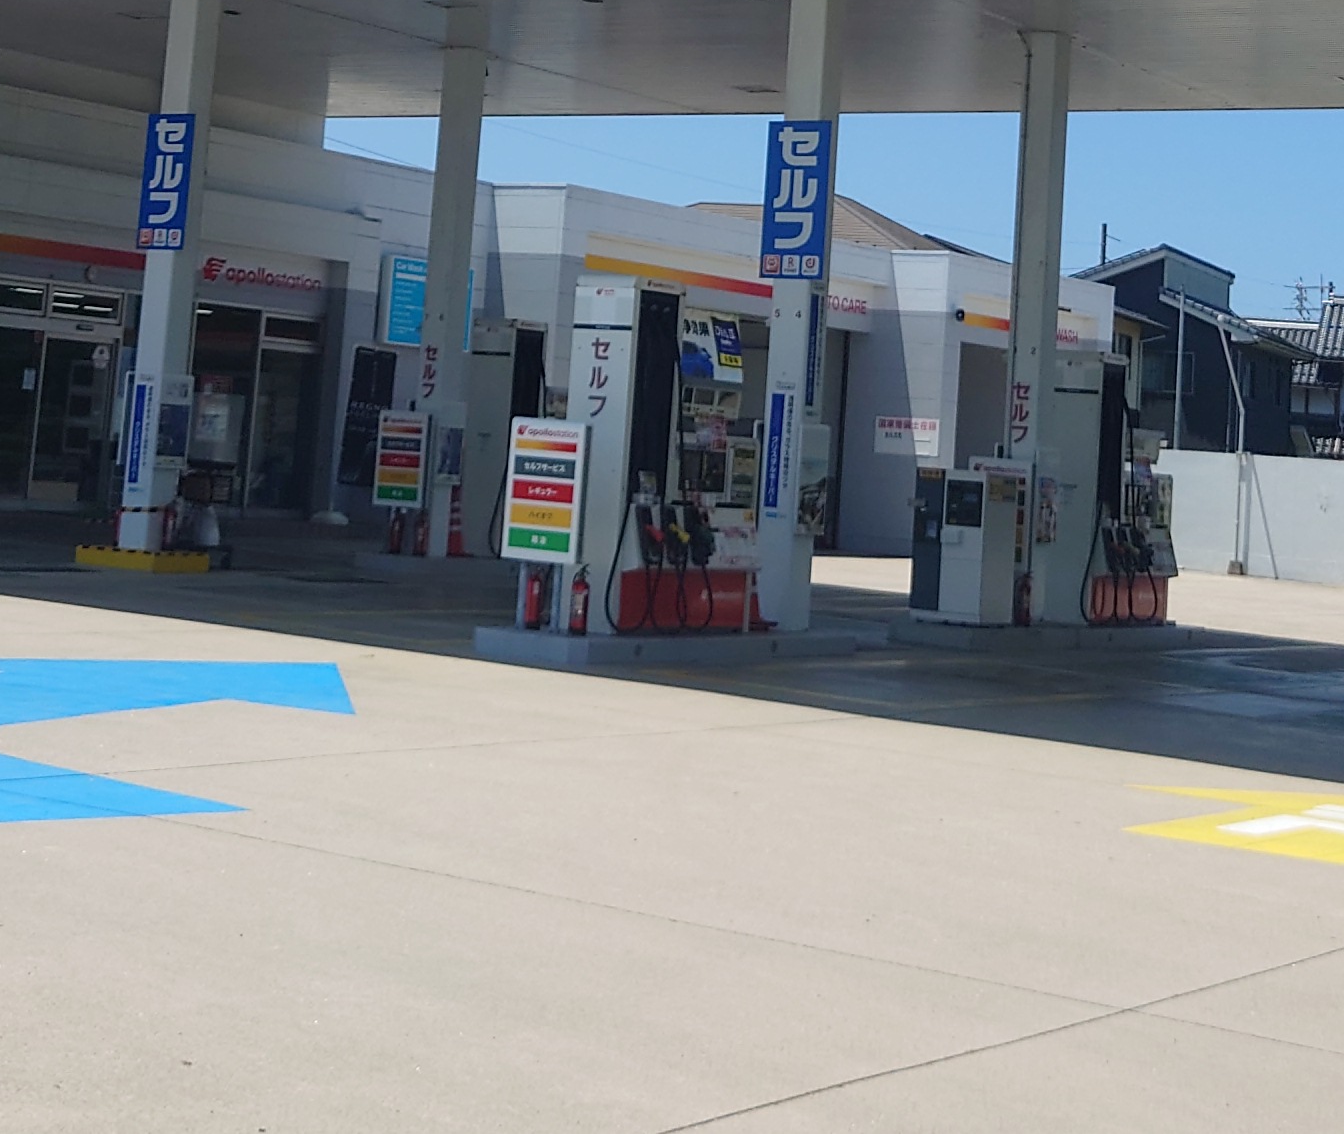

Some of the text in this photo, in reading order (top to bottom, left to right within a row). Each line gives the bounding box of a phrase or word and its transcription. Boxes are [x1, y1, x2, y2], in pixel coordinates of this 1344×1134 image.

[147, 118, 187, 224] セルフ
[772, 126, 820, 250] セルフ
[226, 265, 321, 292] apollostation
[841, 297, 867, 314] CARE
[421, 344, 438, 398] セルフ
[588, 336, 611, 418] セルフ
[528, 427, 579, 439] apollostation
[1011, 381, 1031, 443] セルフ
